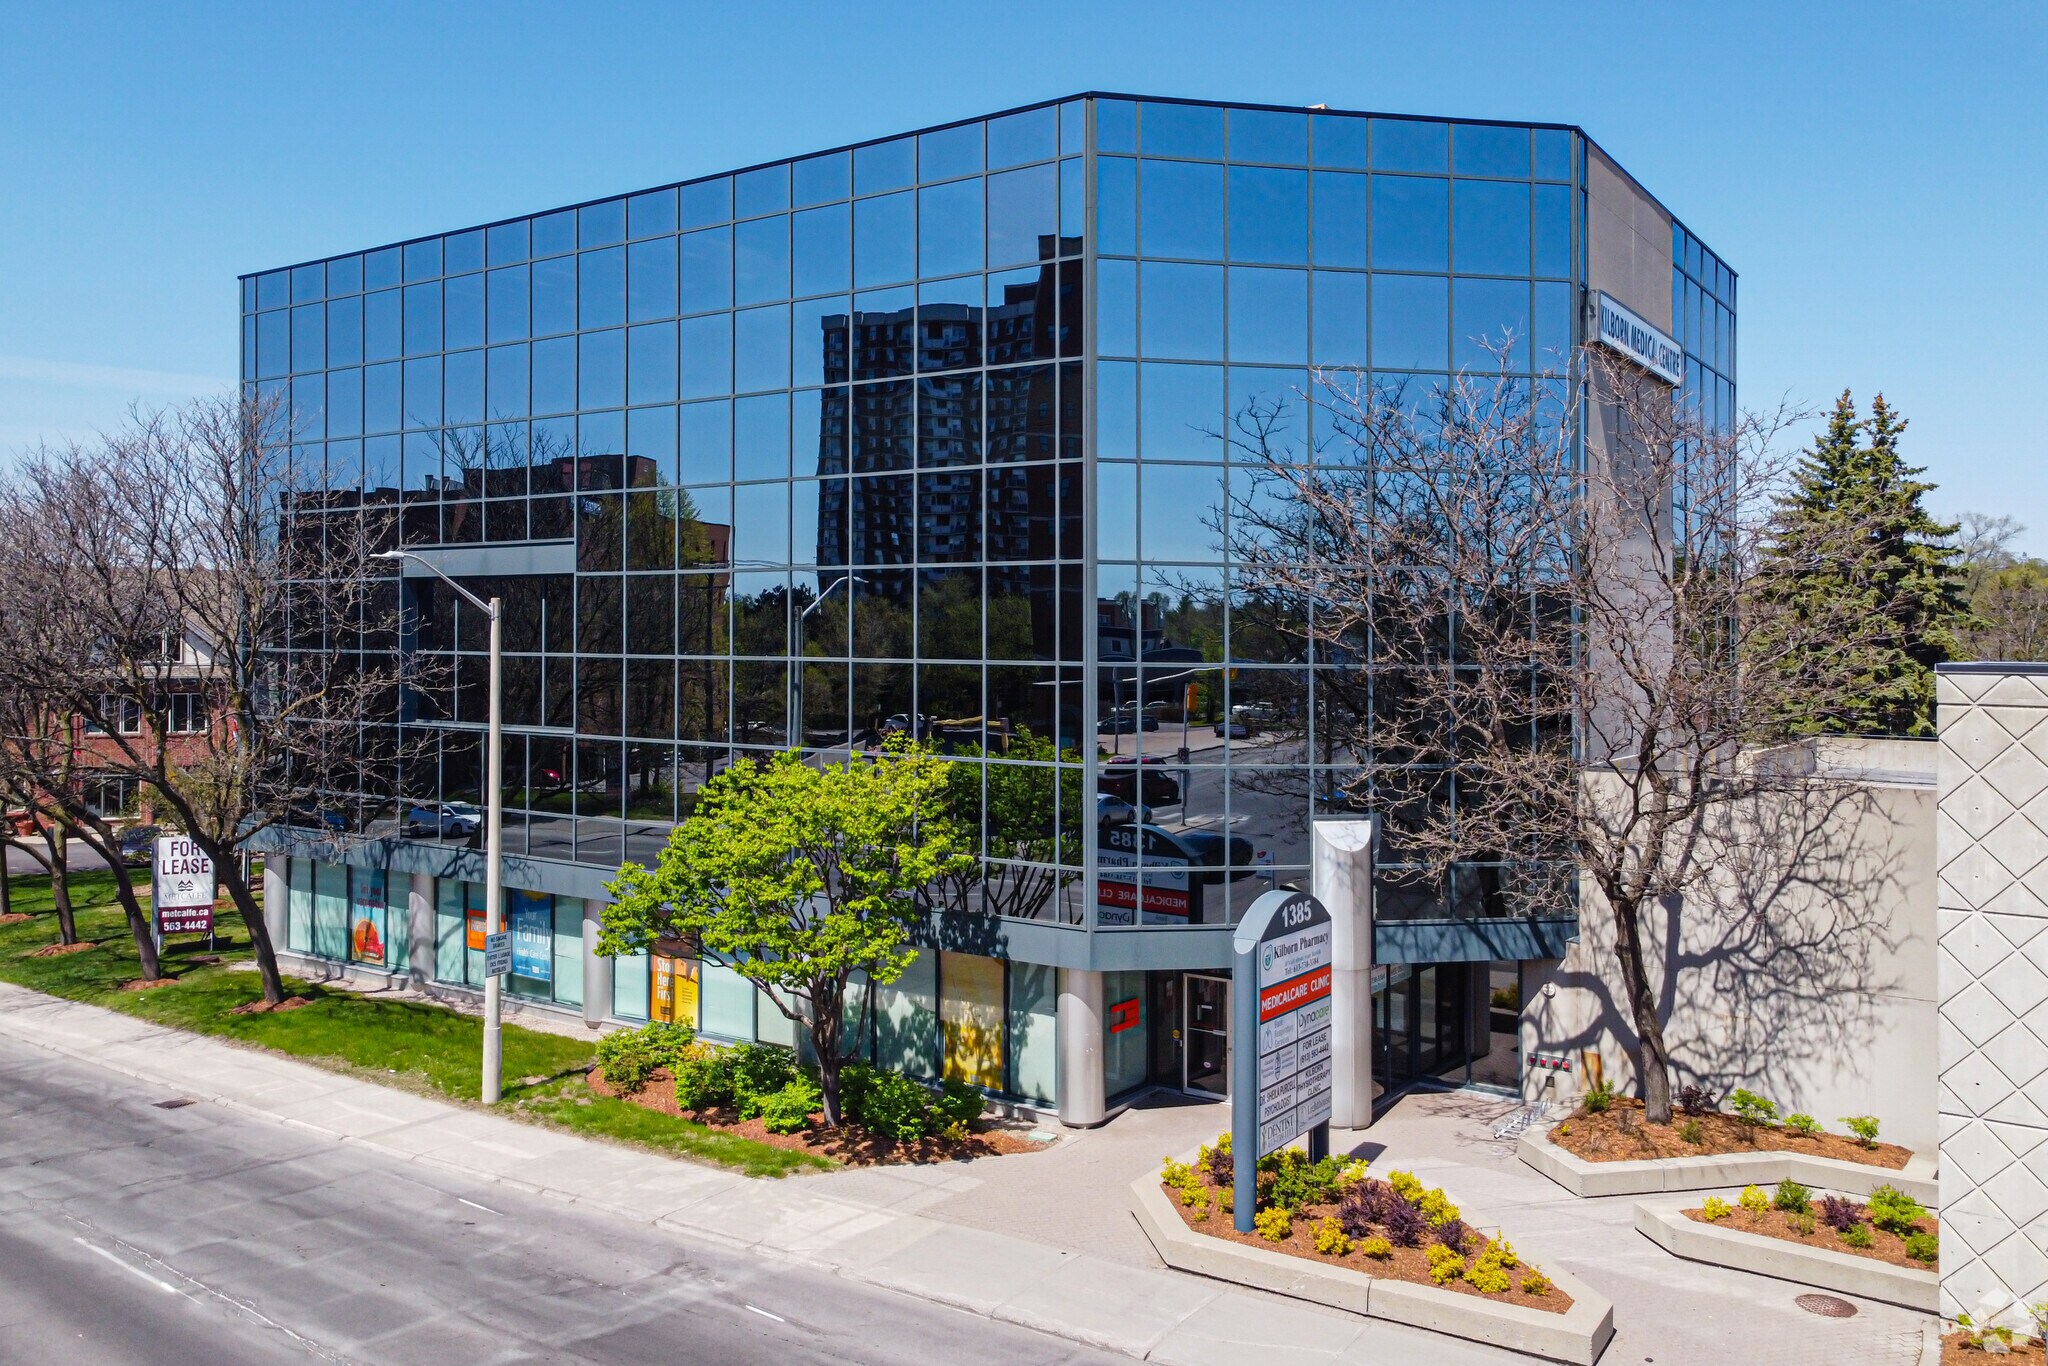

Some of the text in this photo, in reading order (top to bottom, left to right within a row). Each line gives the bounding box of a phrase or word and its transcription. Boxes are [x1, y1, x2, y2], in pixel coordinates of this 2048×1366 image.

[1601, 303, 1629, 348] KILBORN
[1659, 343, 1680, 377] CENTRE
[171, 841, 201, 857] FOR
[162, 858, 209, 875] LEASE
[164, 892, 207, 901] METCALFE
[162, 908, 209, 918] metcalfe.ca
[524, 907, 538, 920] Your
[1282, 900, 1312, 928] 1385
[163, 920, 207, 931] 563-4442
[517, 918, 553, 951] Family
[1274, 932, 1329, 960] Kilborn Pharmacy
[657, 972, 674, 988] Here
[657, 986, 674, 1001] First
[1261, 974, 1330, 1013] MEDICALCARE CLINIC
[1298, 1005, 1330, 1028] Dynacare
[1302, 1032, 1327, 1051] FOR LEASE
[1305, 1063, 1324, 1078] KILBORN
[1280, 1080, 1296, 1097] PURCELL
[1297, 1068, 1331, 1092] PHYSIOTHERAPY
[1307, 1083, 1321, 1097] CLINIC
[1264, 1094, 1292, 1117] PSYCHOLOGIST
[1267, 1113, 1295, 1140] DENTIST
